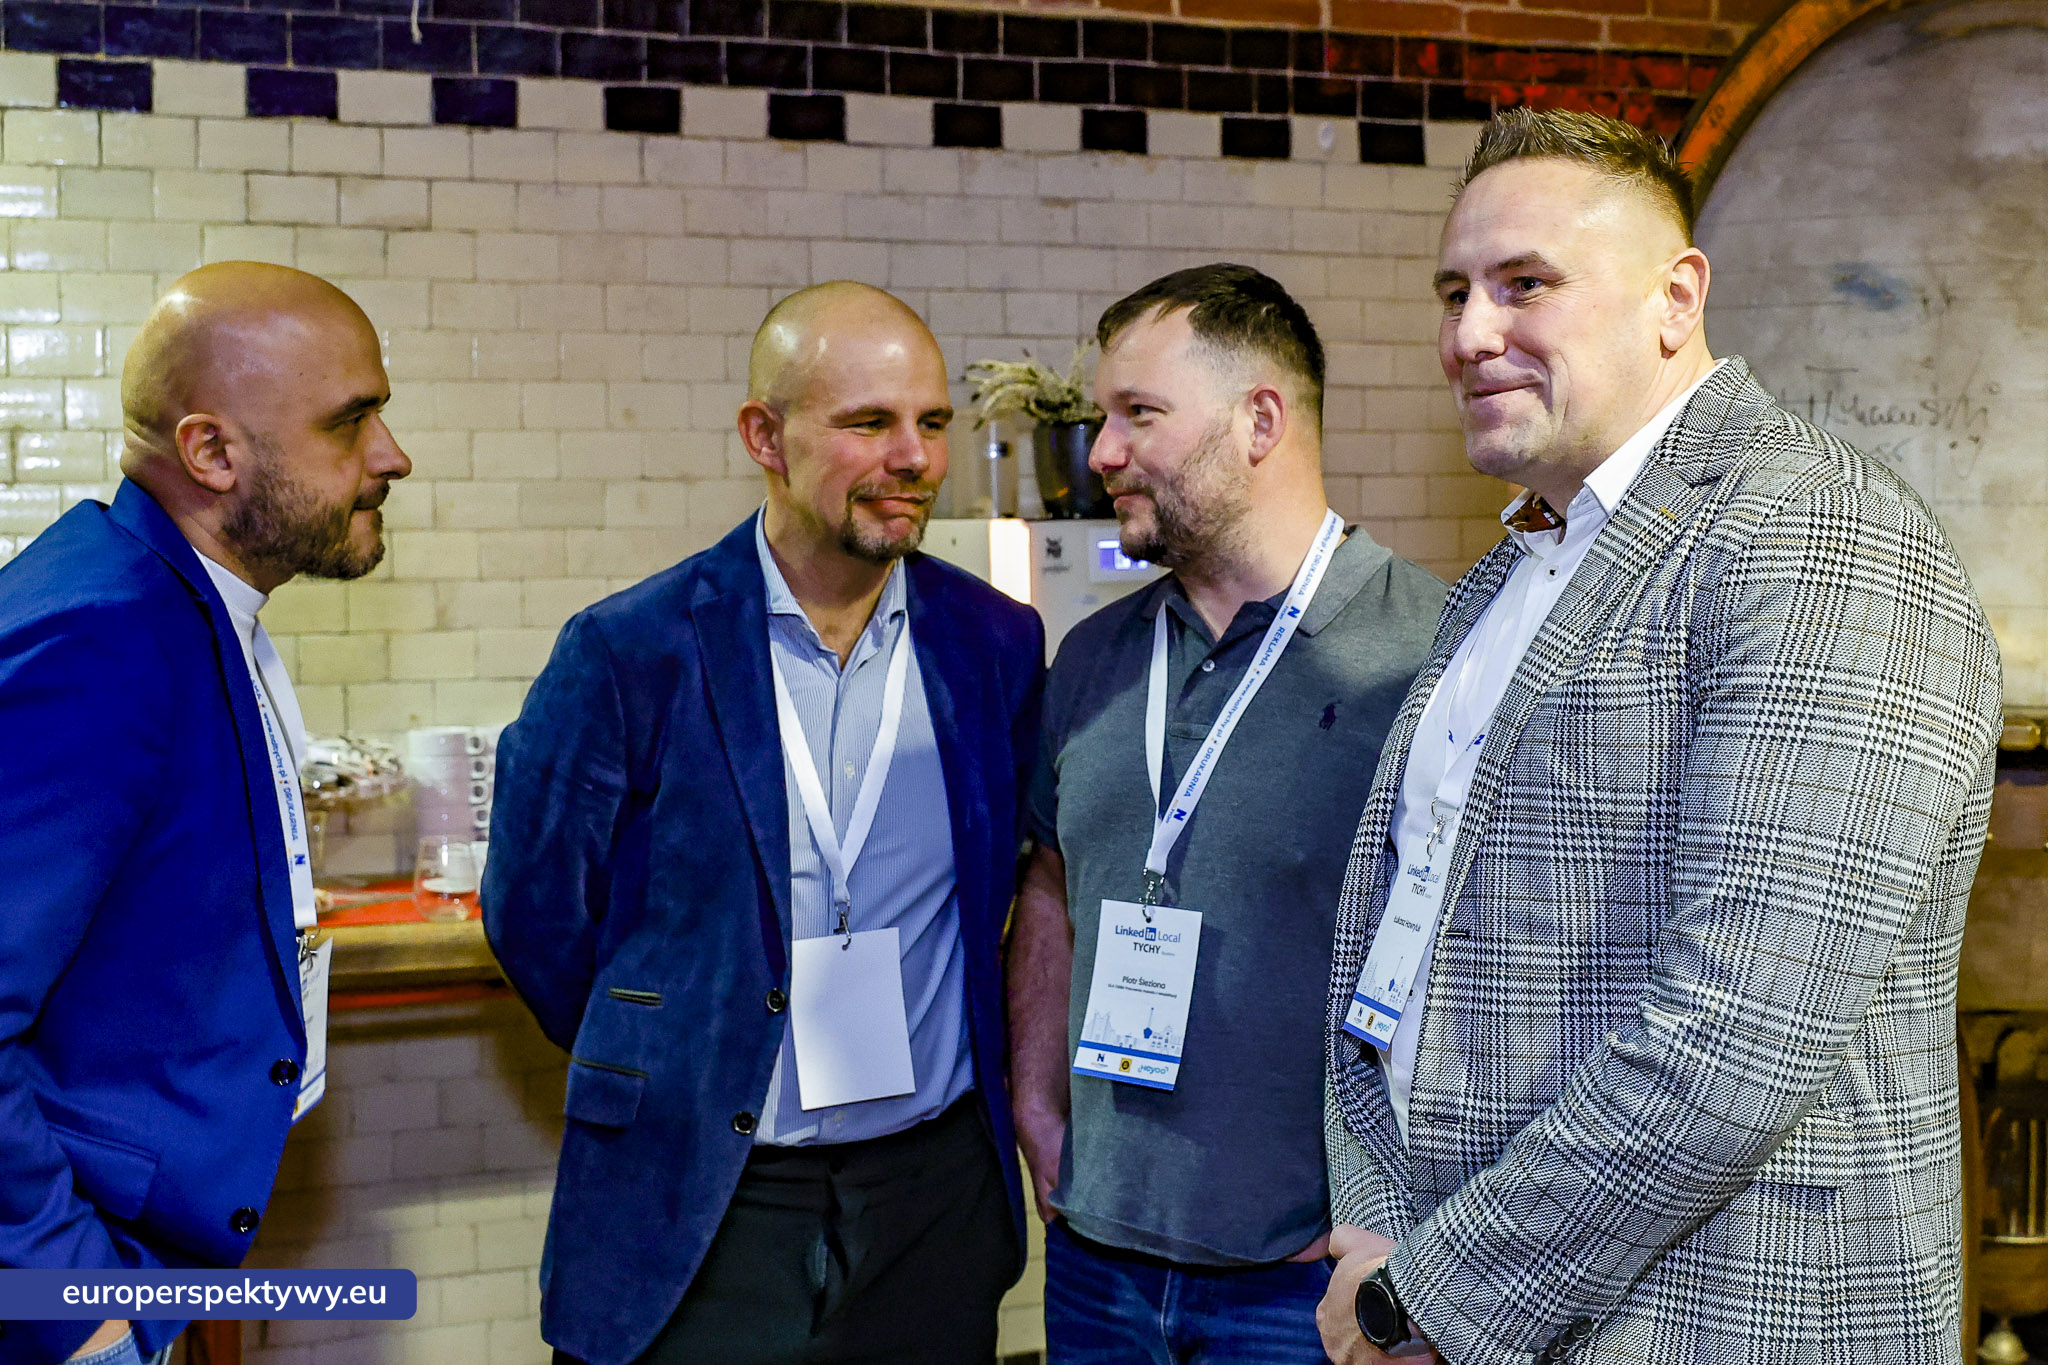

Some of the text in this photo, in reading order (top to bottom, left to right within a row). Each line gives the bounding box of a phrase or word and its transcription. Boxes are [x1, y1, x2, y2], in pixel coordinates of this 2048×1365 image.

[1259, 626, 1286, 667] REKLAMA
[1183, 747, 1214, 798] DRUKARNIA
[1133, 942, 1161, 954] TYCHY
[1158, 931, 1181, 943] Local
